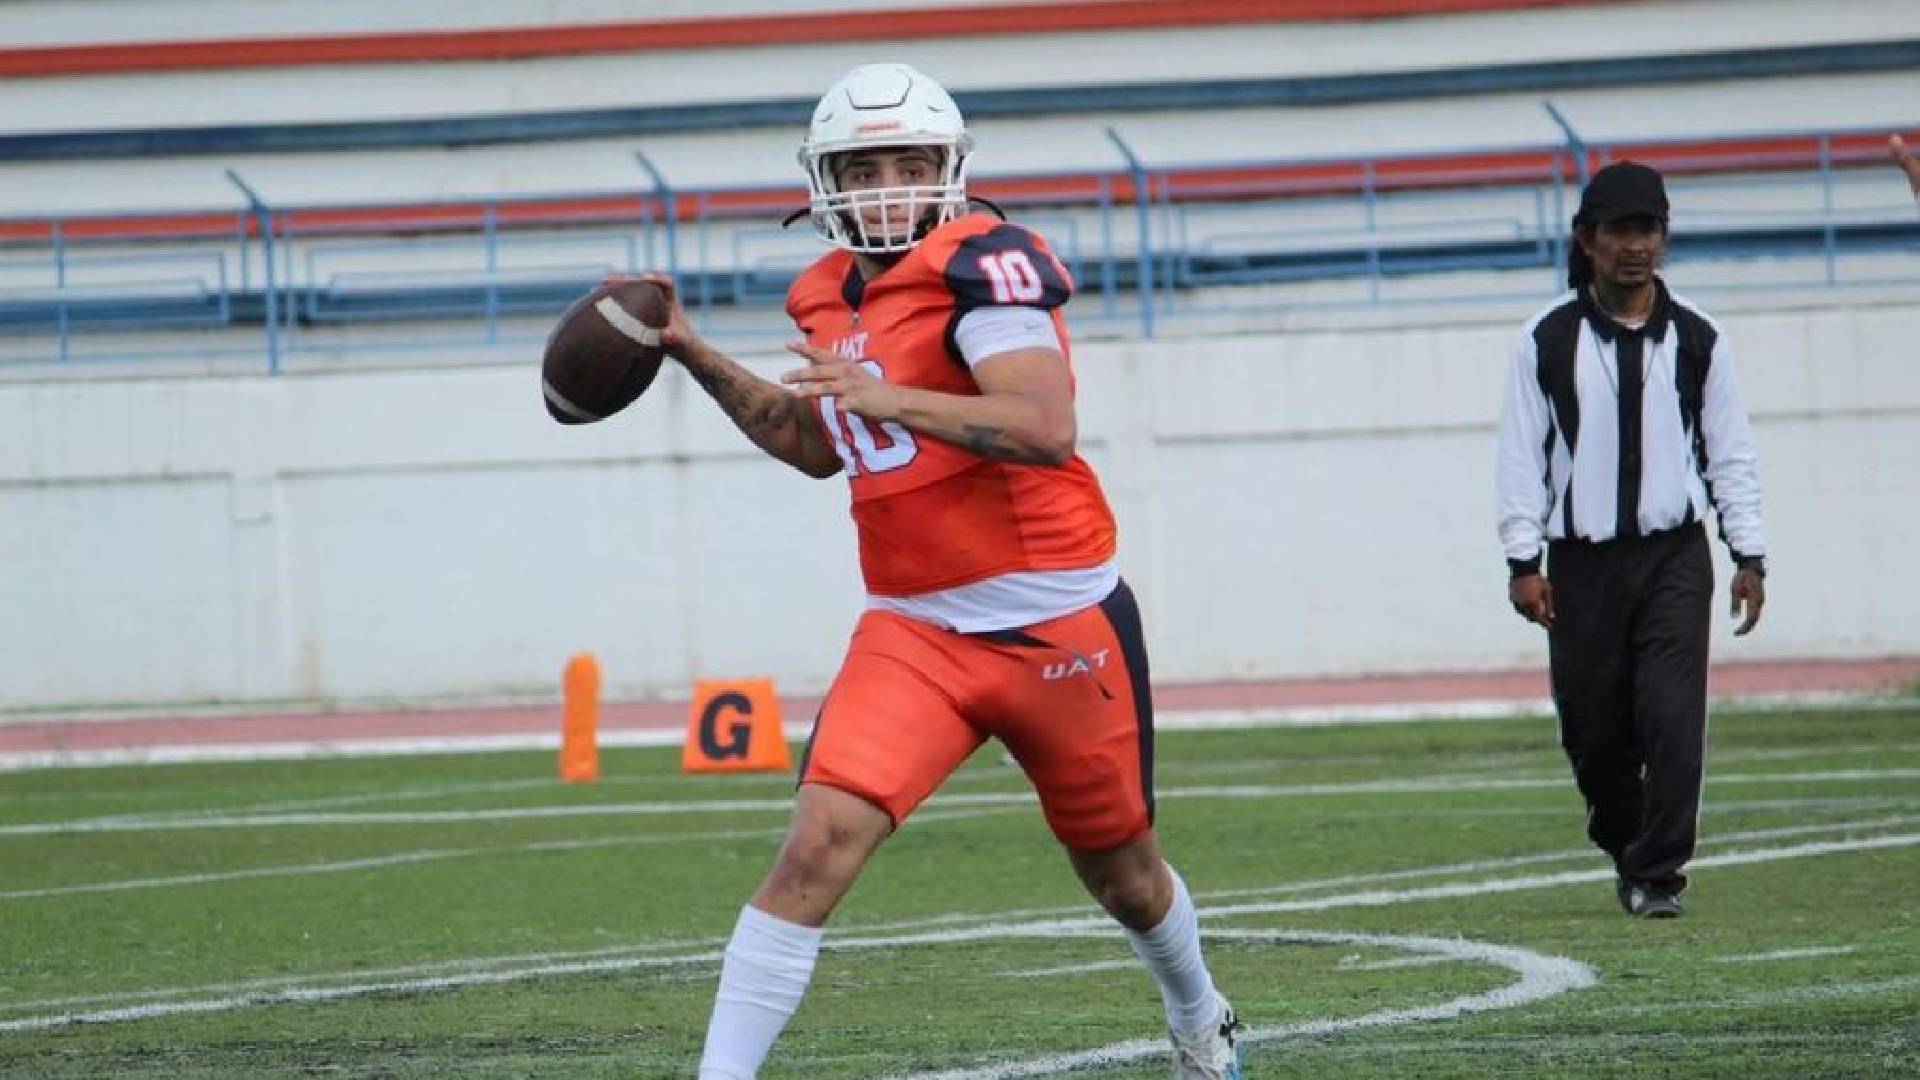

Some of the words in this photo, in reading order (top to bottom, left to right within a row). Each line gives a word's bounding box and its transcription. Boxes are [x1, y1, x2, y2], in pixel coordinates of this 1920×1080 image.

[979, 250, 1042, 303] 10
[1042, 648, 1110, 680] UAT
[700, 691, 752, 760] G
